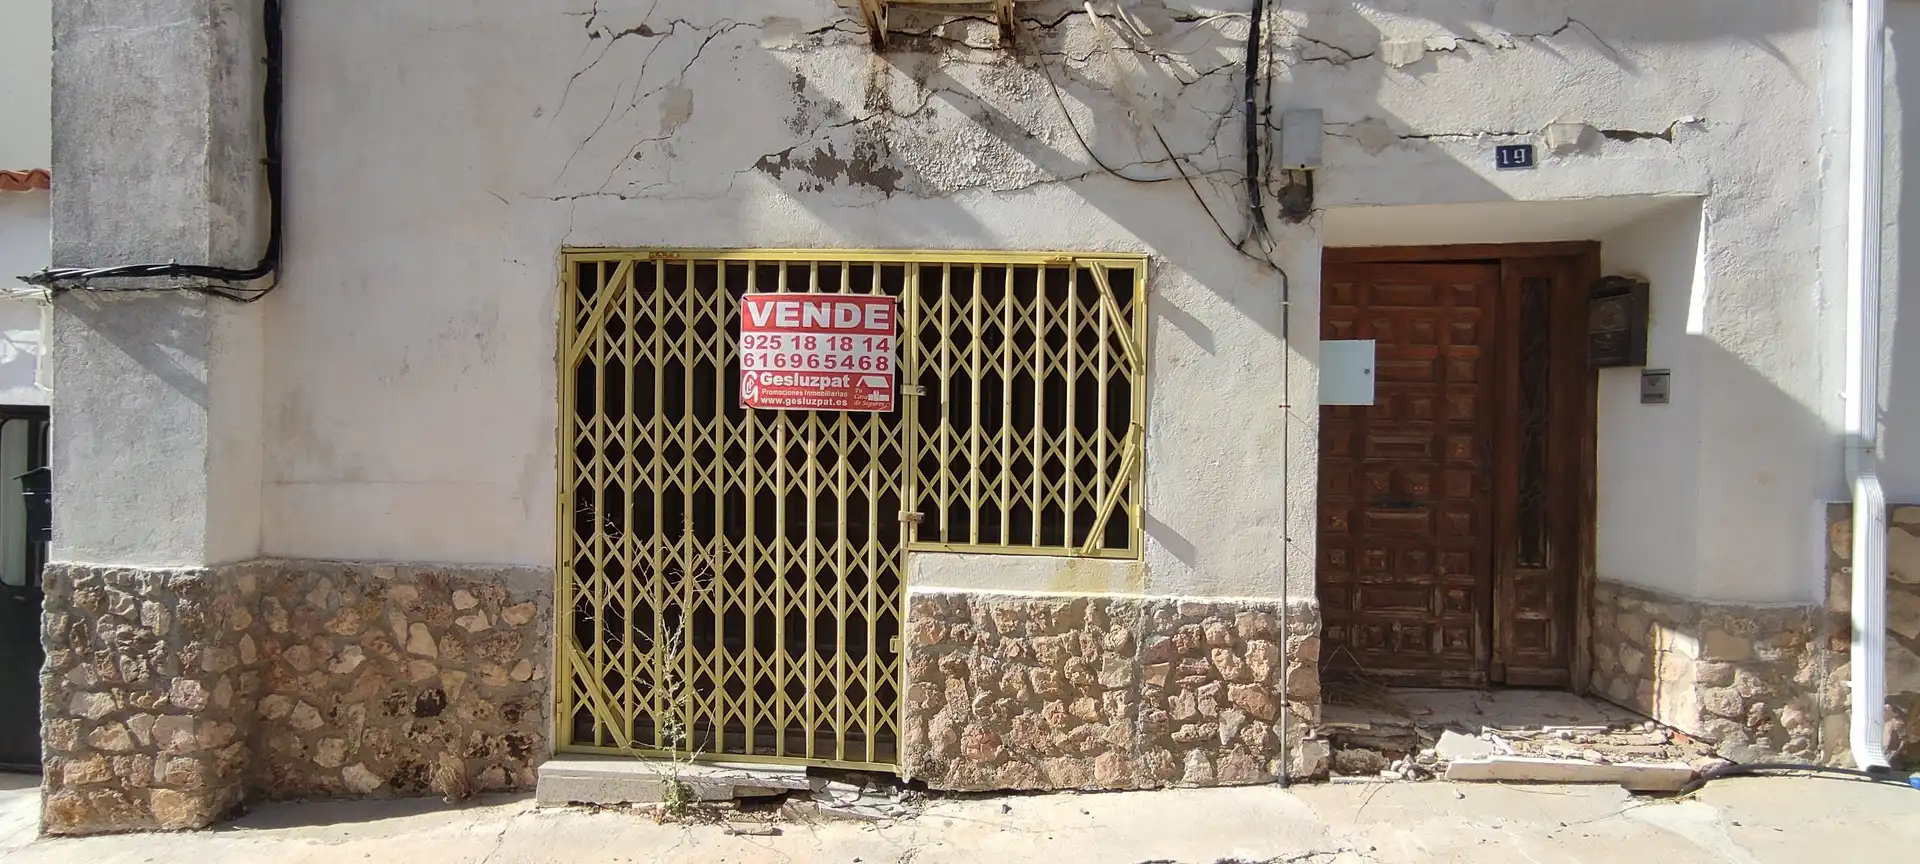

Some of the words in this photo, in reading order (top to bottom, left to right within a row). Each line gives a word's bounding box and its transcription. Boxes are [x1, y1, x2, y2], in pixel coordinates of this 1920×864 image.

[1502, 148, 1526, 164] 19
[747, 301, 890, 330] VENDE
[743, 334, 782, 350] 925
[791, 335, 817, 351] 18
[826, 336, 853, 352] 18
[862, 337, 890, 353] 14
[743, 352, 889, 371] 616965468
[760, 372, 850, 390] Gesluzpat
[760, 397, 848, 406] www.gesluzpat.es
